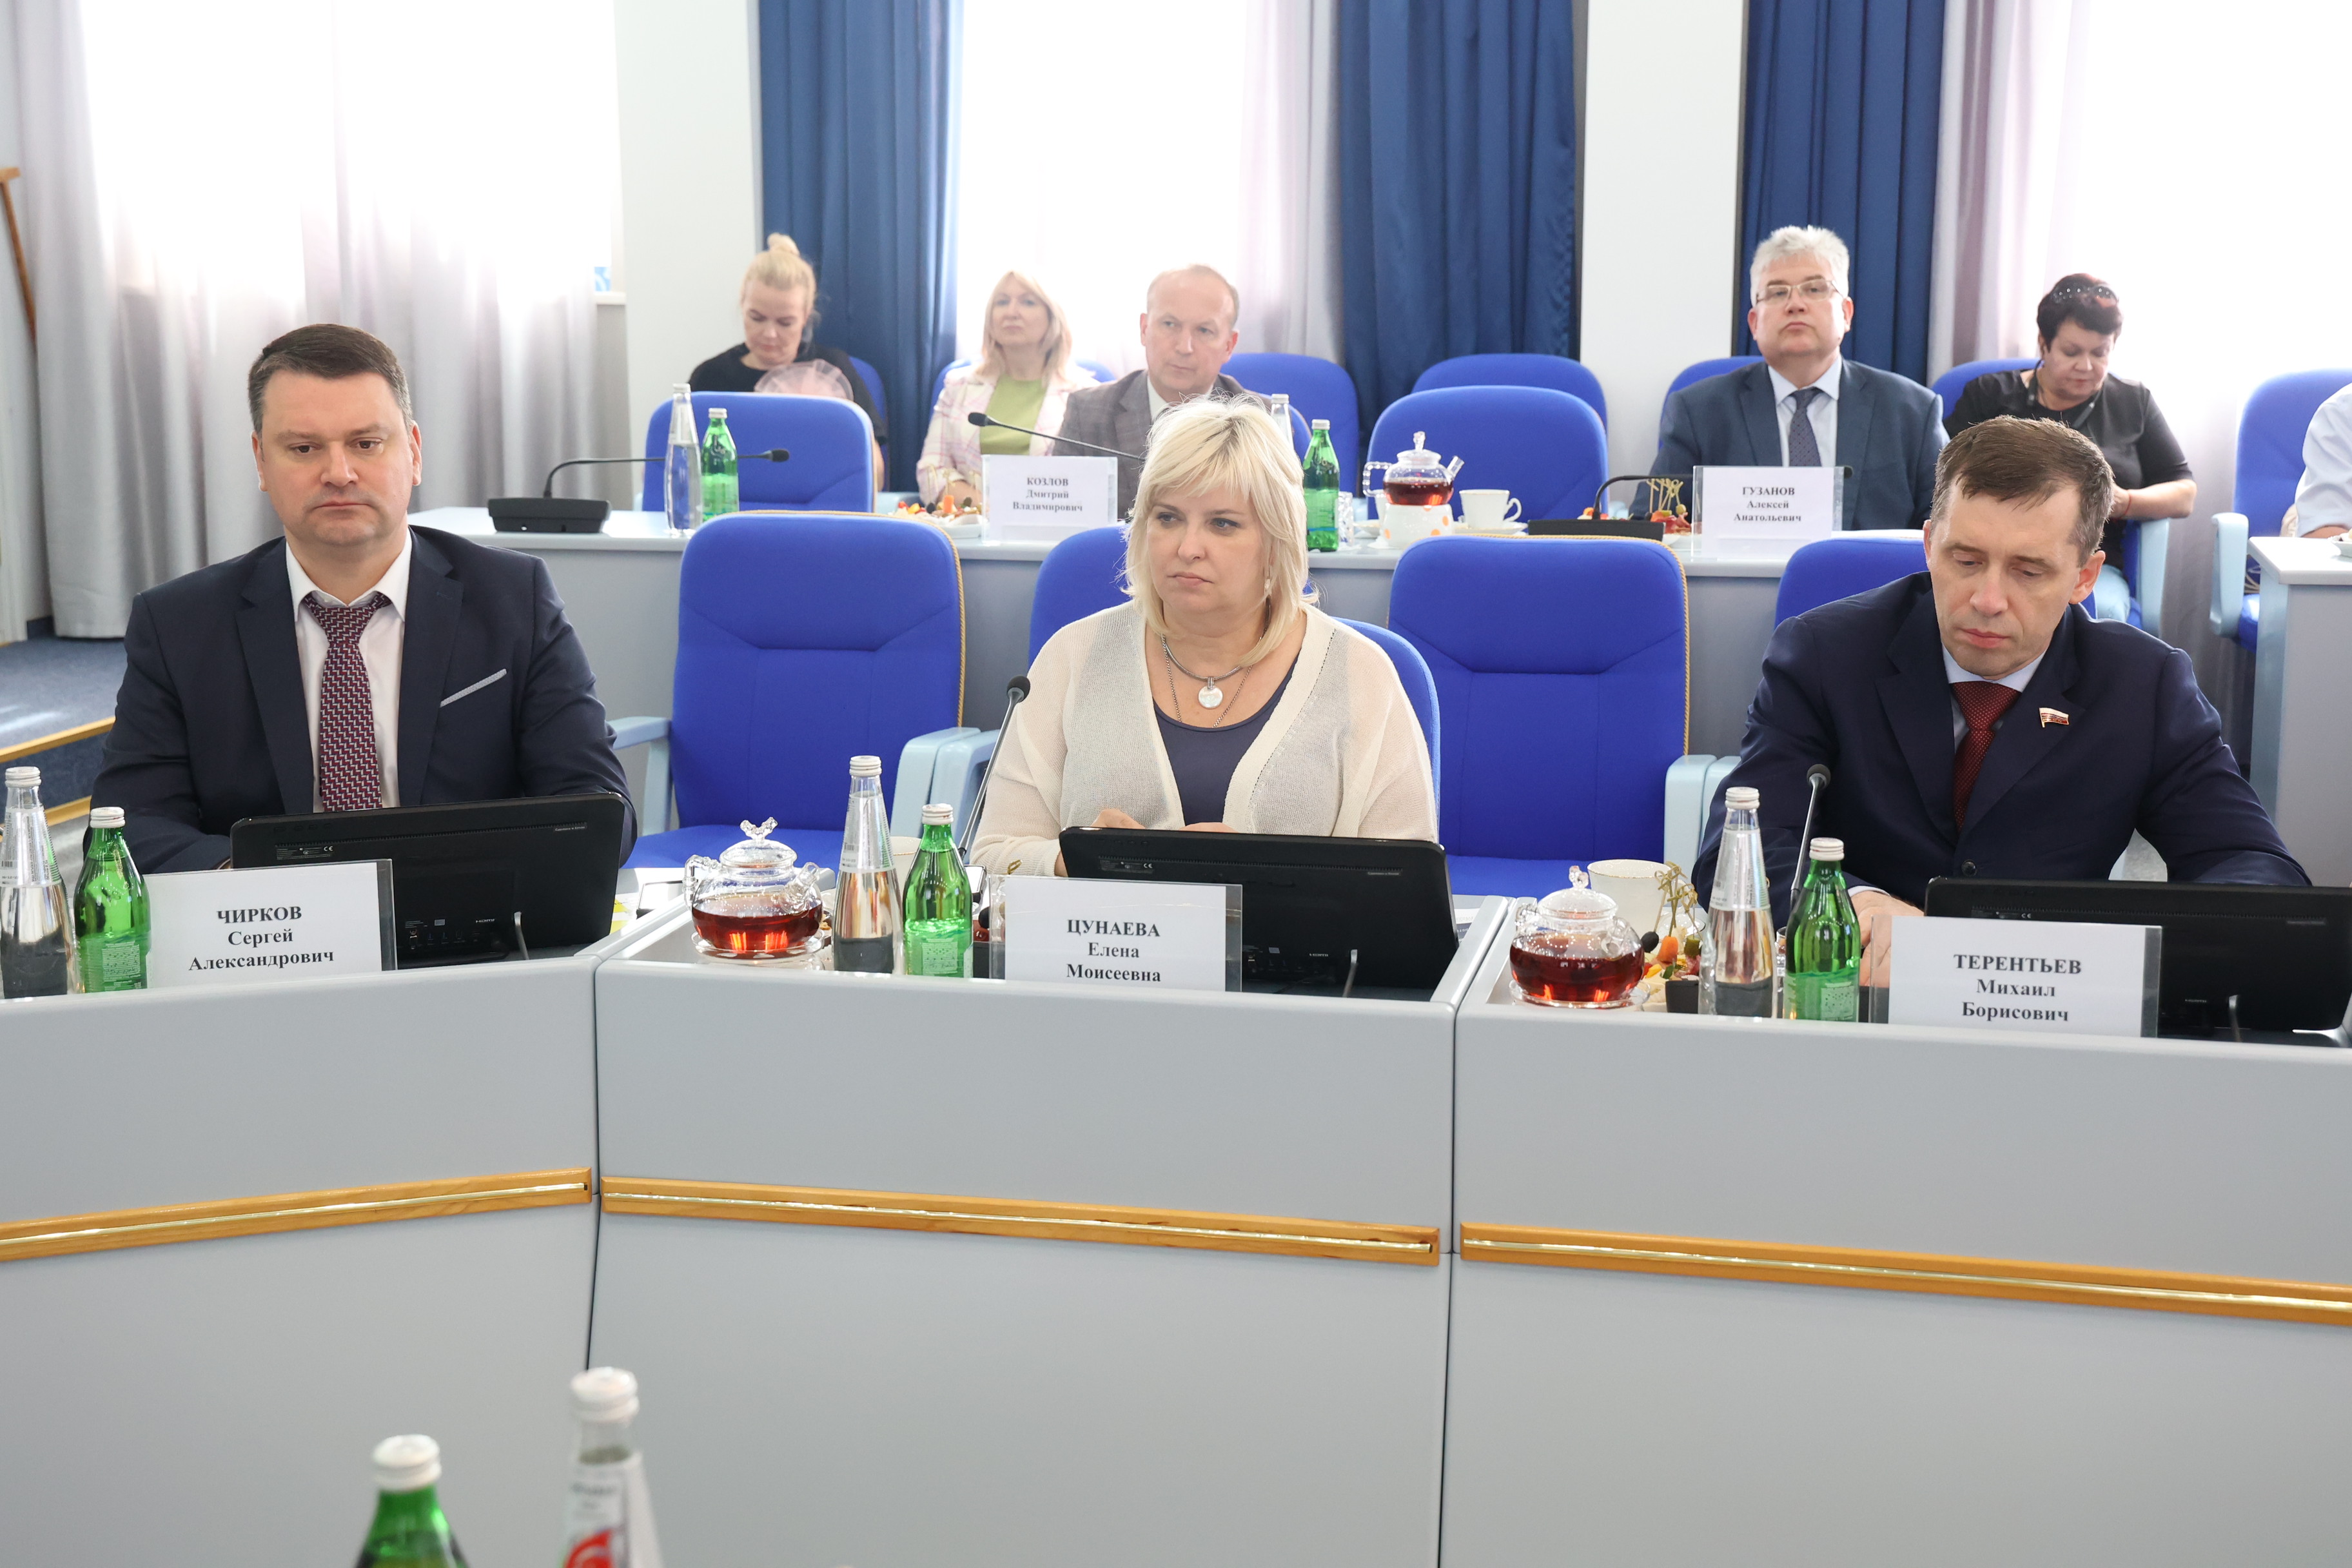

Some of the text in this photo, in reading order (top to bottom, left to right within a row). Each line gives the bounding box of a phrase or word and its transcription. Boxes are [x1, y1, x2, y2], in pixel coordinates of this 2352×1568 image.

[1027, 477, 1069, 486] КОЗЛОВ
[1026, 489, 1069, 500] Дмитрий
[1743, 487, 1795, 495] ГУЗАНОВ
[1013, 502, 1083, 513] Владимирович
[1747, 500, 1789, 509] Алексей
[1734, 513, 1801, 522] Анатольевич
[217, 906, 302, 924] ЧИРКОВ
[1067, 919, 1161, 937] ЦУНАЕВА
[228, 928, 293, 948] Сергей
[1088, 942, 1139, 957] Елена
[188, 951, 334, 971] Александрович
[1954, 954, 2082, 974] ТЕРЕНТЬЕВ
[1066, 963, 1161, 982] Моисеевна
[1977, 979, 2055, 997] Михаил
[1962, 1001, 2069, 1021] Борисович
